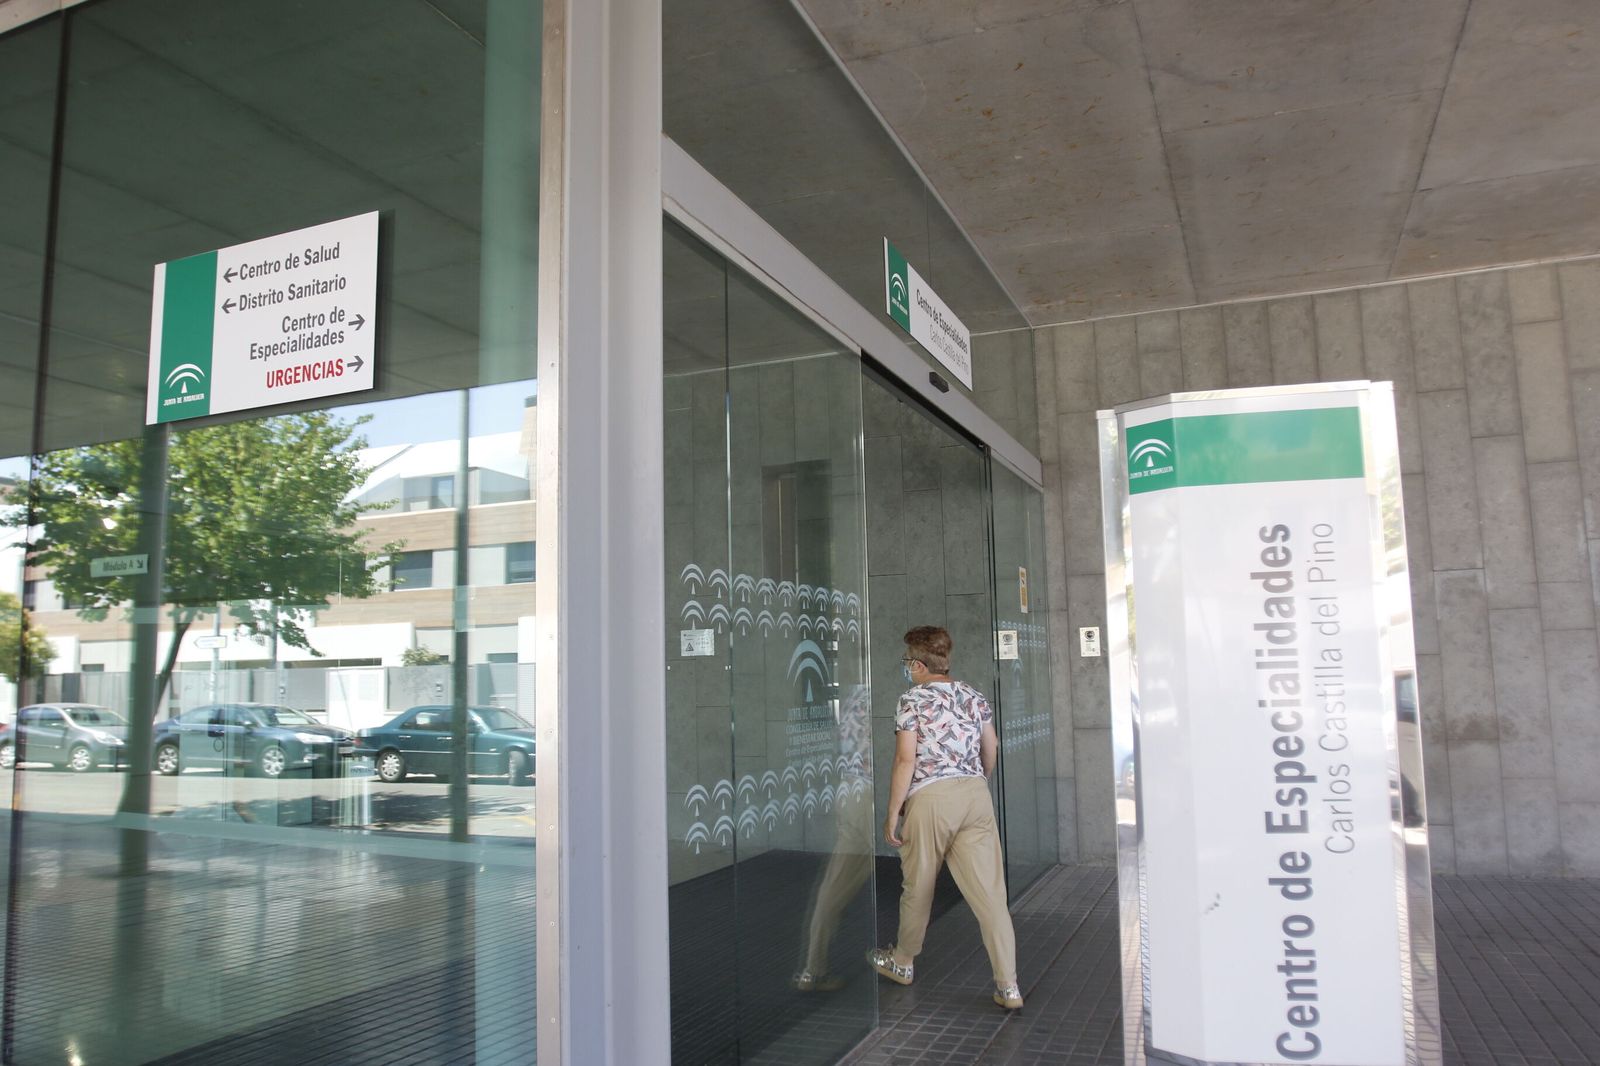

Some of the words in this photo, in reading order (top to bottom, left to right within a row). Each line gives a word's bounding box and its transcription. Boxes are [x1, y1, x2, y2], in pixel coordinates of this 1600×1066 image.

[240, 258, 281, 281] Centro
[285, 252, 300, 270] de
[304, 242, 341, 266] Salud
[239, 289, 284, 312] Distrito
[288, 273, 347, 301] Sanitario
[916, 288, 933, 318] Centro
[933, 307, 939, 324] de
[282, 312, 325, 333] Centro
[330, 305, 345, 323] de
[250, 329, 345, 361] Especialidades
[266, 358, 344, 389] URGENCIAS
[1306, 522, 1337, 583] Pino
[1309, 596, 1341, 637] del
[1249, 523, 1318, 834] Especialidades
[1313, 648, 1350, 752] Castilla
[1321, 763, 1356, 854] Carlos
[1267, 850, 1314, 901] de
[1275, 913, 1323, 1061] Centro
